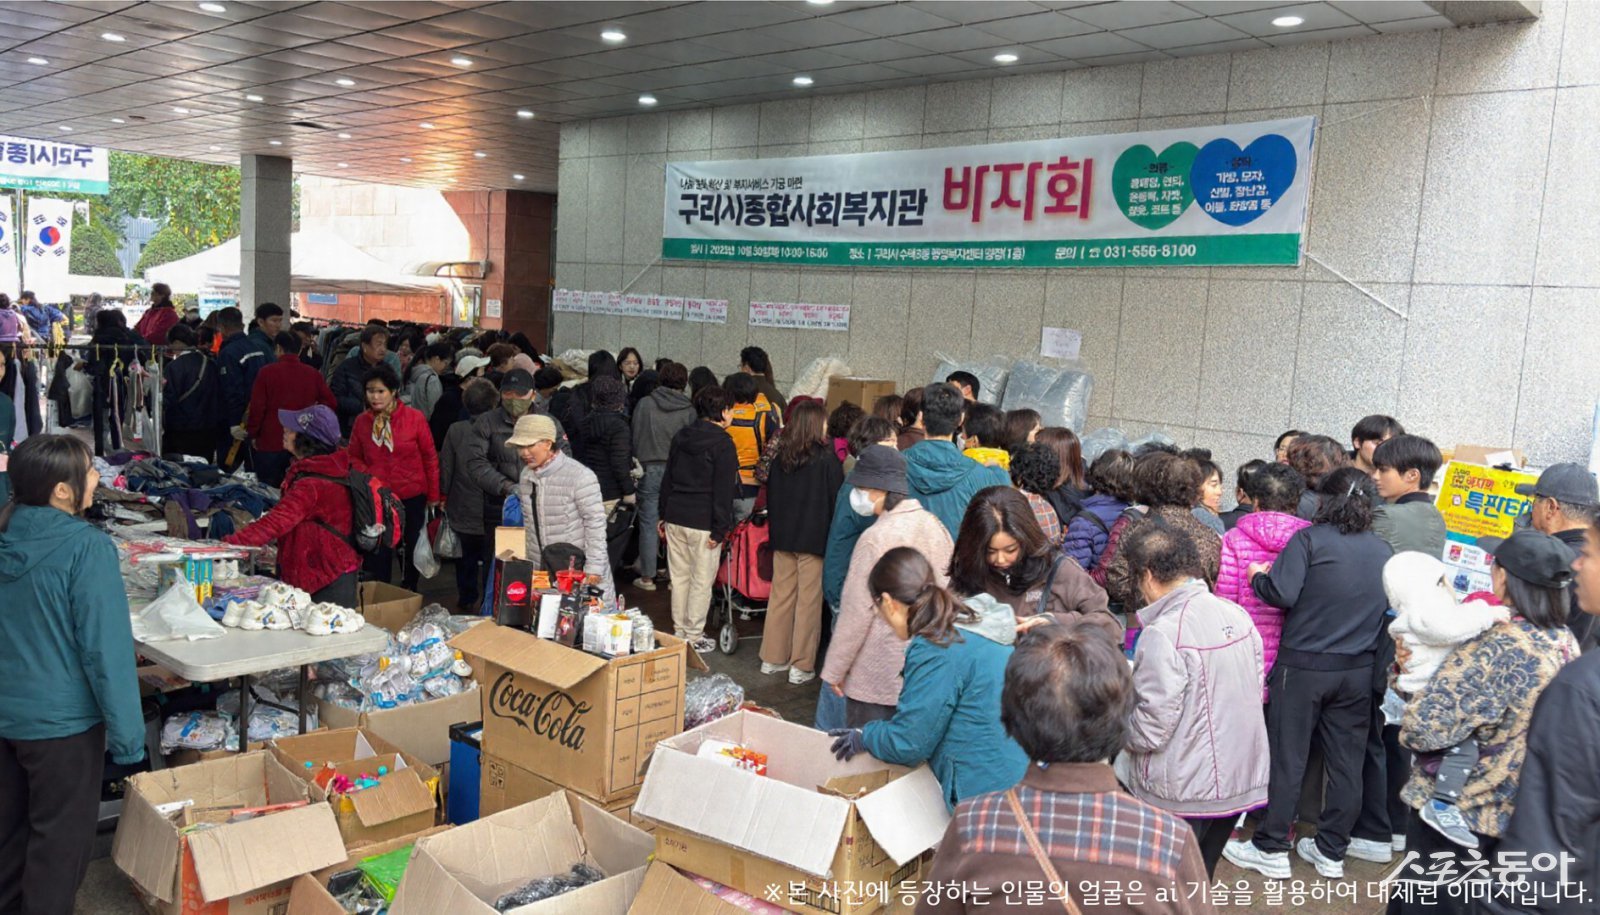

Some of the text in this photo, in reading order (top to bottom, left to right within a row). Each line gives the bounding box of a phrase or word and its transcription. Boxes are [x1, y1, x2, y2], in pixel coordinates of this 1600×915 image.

[943, 156, 1093, 222] 바자회
[1216, 170, 1264, 183] 가방, 모자,
[679, 188, 928, 227] 구리시종합사회복지관
[1103, 244, 1197, 259] 031-556-8100
[489, 671, 593, 750] Coca-Cola
